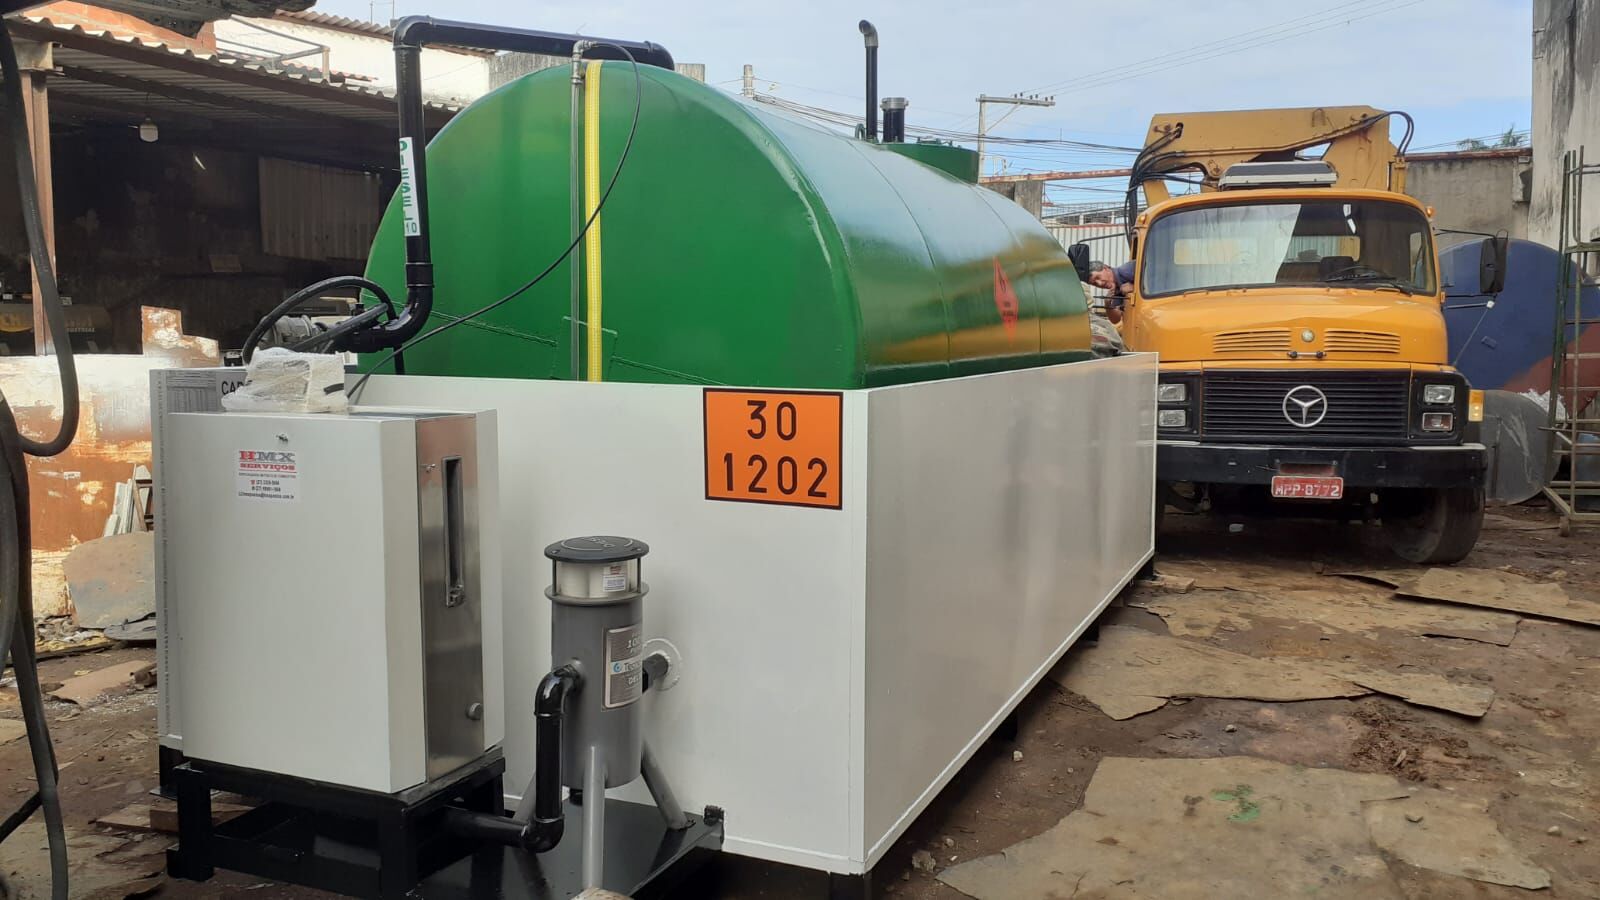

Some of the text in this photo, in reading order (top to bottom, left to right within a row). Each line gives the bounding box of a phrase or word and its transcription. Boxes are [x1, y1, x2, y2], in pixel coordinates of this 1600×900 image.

[747, 399, 797, 441] 30
[239, 450, 296, 463] HMX
[723, 452, 828, 498] 1202
